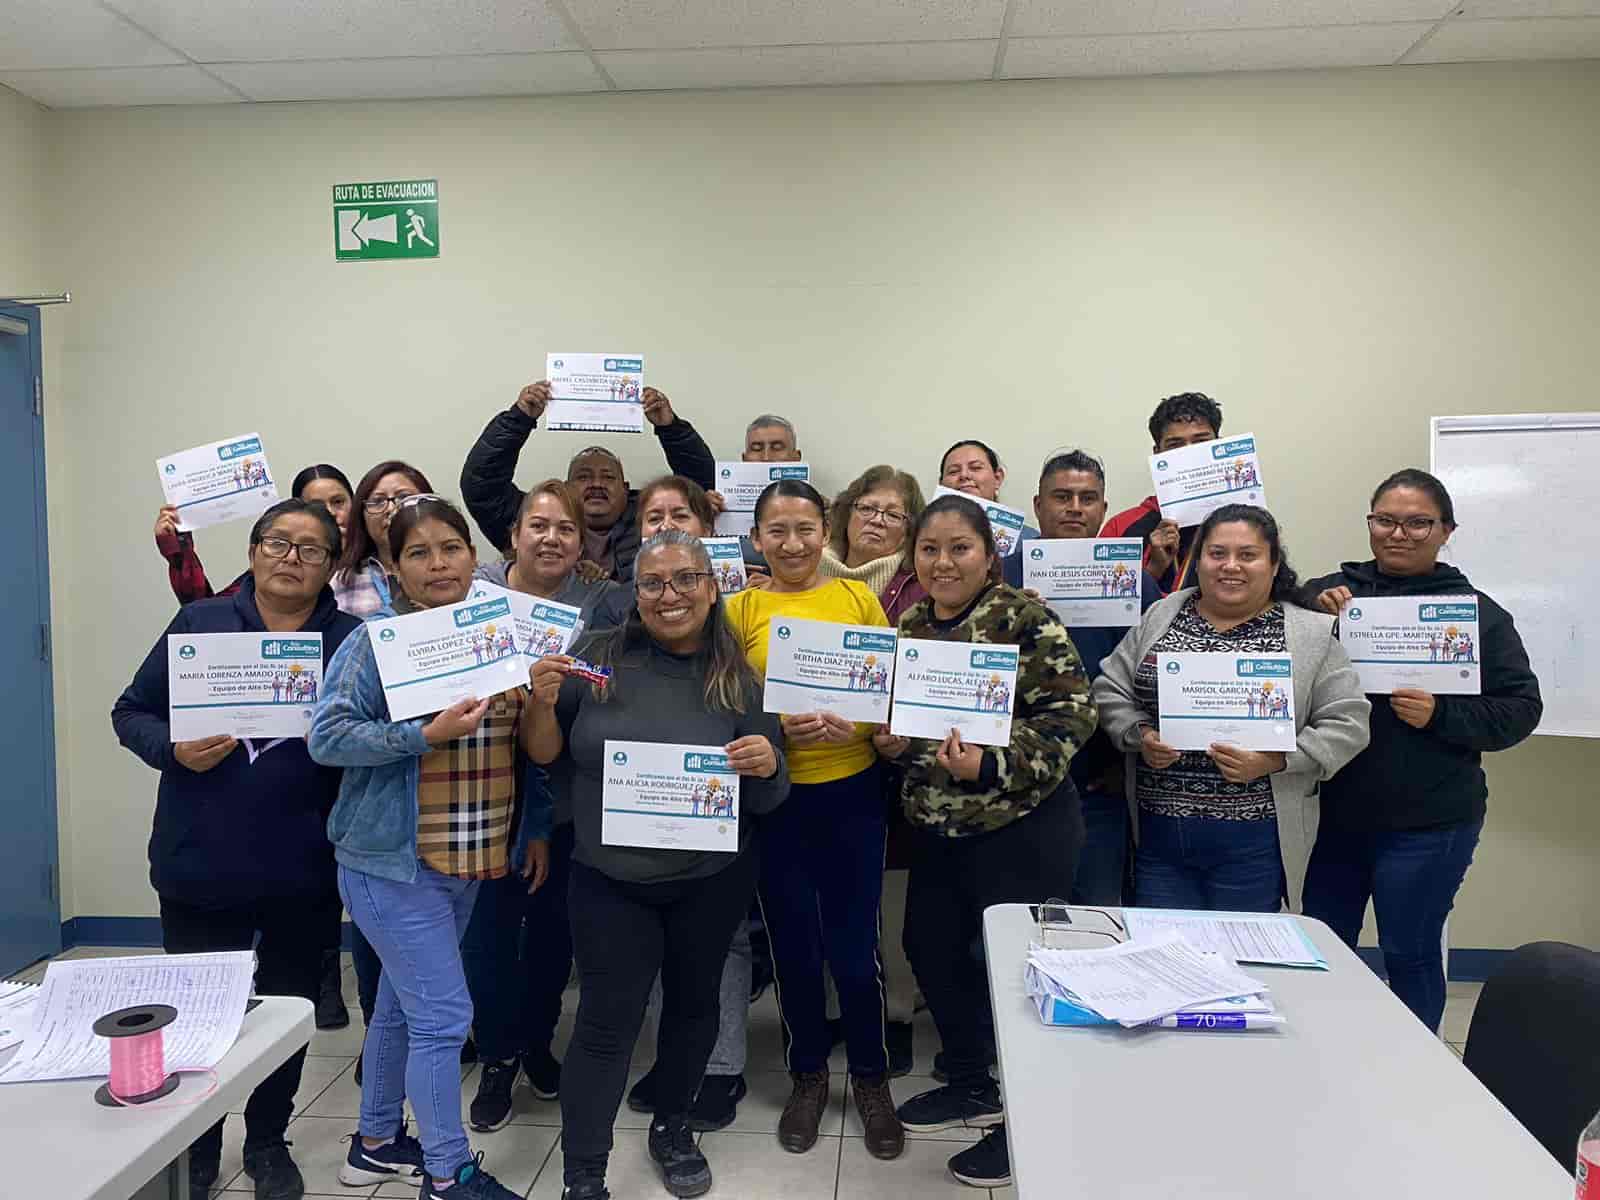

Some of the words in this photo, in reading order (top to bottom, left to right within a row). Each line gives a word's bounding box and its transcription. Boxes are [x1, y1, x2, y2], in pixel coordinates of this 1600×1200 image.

[335, 185, 360, 200] RUTA
[362, 185, 374, 199] DE
[376, 182, 435, 198] EVACUACION
[1048, 570, 1059, 578] DE
[1060, 569, 1081, 577] JESUS
[1350, 631, 1384, 639] ESTRELLA
[1403, 631, 1442, 639] MARTINEZ
[283, 644, 320, 652] Consulting
[408, 645, 437, 657] ELVIRA
[438, 638, 464, 651] LOPEZ
[794, 653, 822, 664] BERTHA
[824, 656, 842, 666] DIAZ
[1256, 664, 1289, 672] Consulting
[180, 672, 206, 680] MARIA
[207, 671, 242, 680] LORENZA
[244, 670, 273, 678] AMADO
[908, 672, 937, 682] ALFARO
[1182, 686, 1216, 694] MARISOL
[1219, 686, 1249, 694] GARCIA
[608, 778, 624, 786] ANA
[624, 778, 650, 788] ALICIA
[650, 780, 694, 791] RODRIGUEZ
[1194, 1014, 1216, 1028] 70
